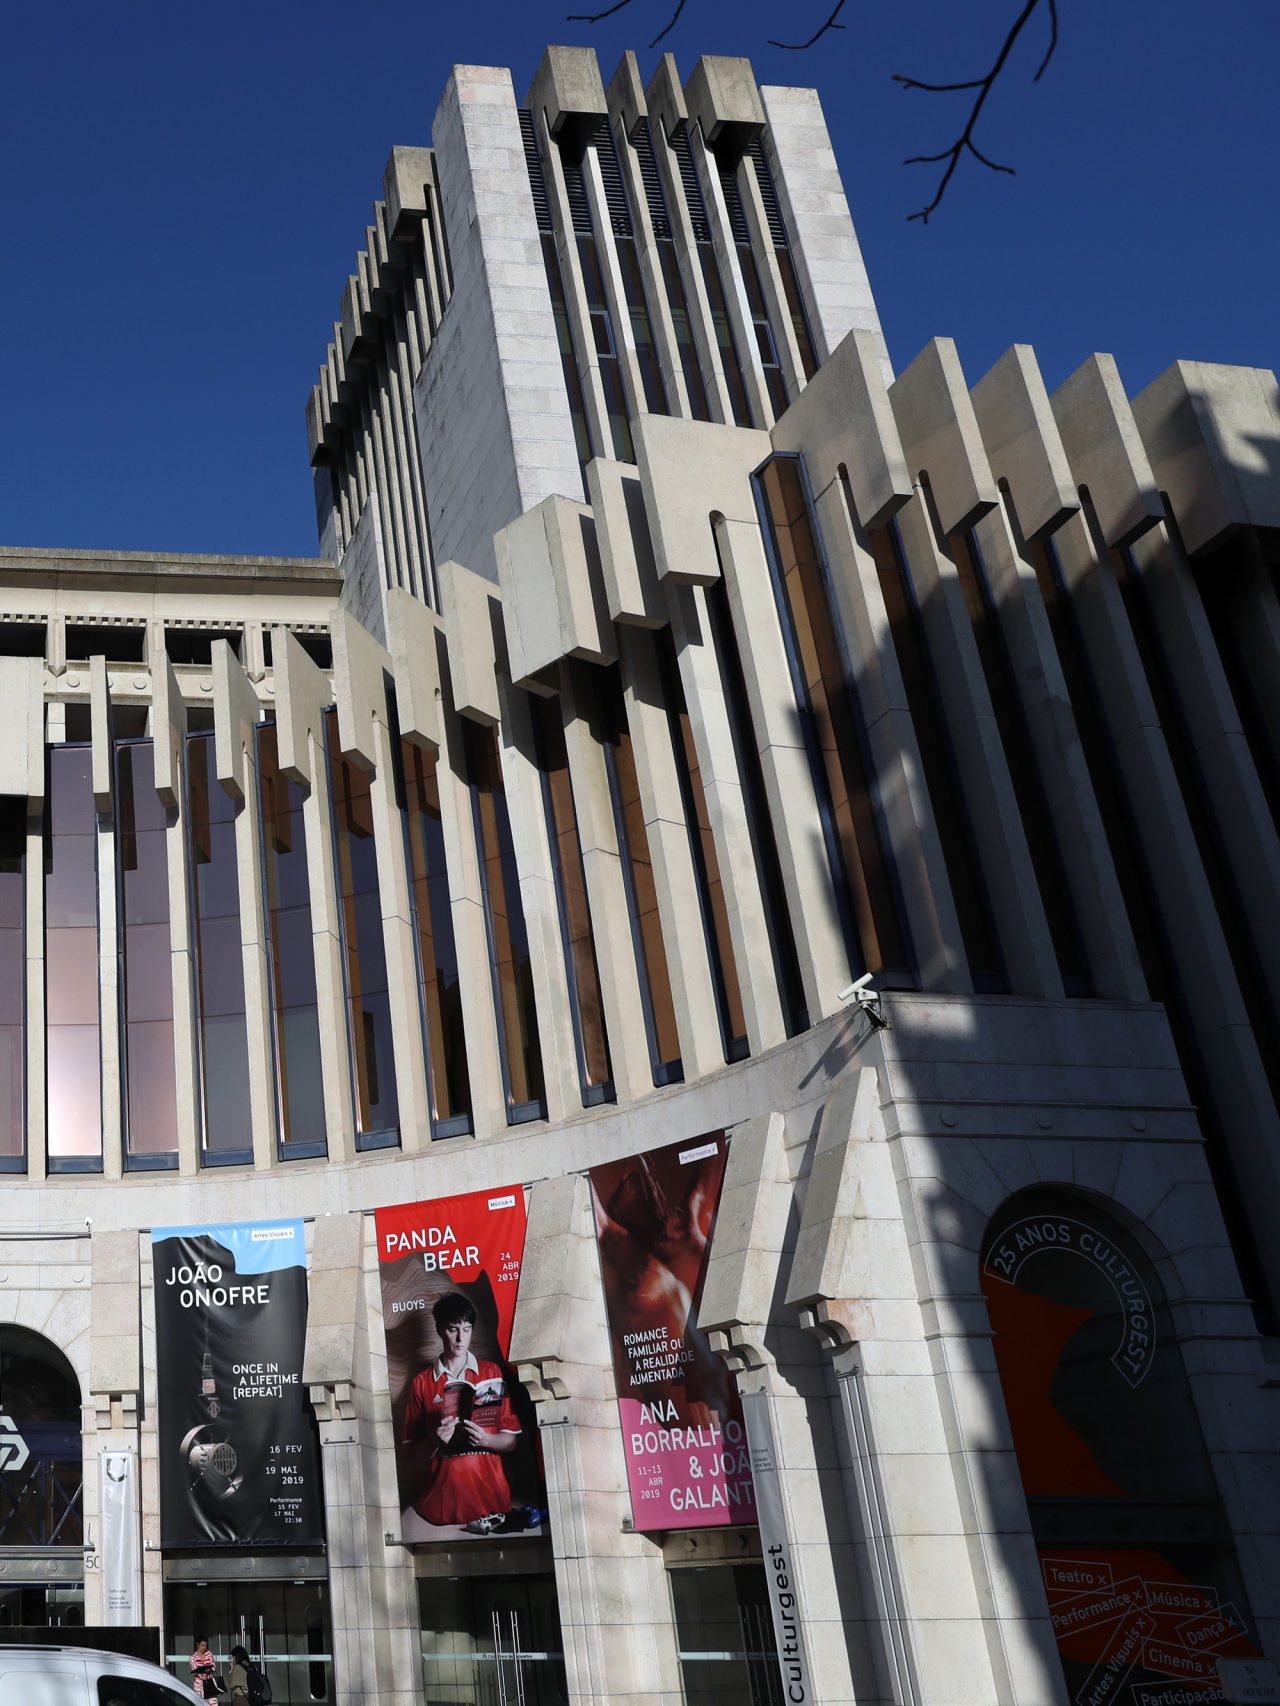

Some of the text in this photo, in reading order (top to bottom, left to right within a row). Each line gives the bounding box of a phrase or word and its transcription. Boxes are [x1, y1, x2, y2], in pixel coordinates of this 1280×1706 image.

[385, 1225, 457, 1253] PANDA
[423, 1246, 480, 1272] BEAR
[500, 1252, 511, 1261] 24
[502, 1261, 519, 1271] ABR
[165, 1261, 223, 1286] JOÃO
[497, 1271, 519, 1282] 2019
[392, 1299, 425, 1313] BUOYS
[993, 1223, 1148, 1374] 25 ANOS CULTURGEST
[624, 1327, 668, 1346] ROMANCE
[628, 1338, 684, 1359] FAMILIAR OU
[232, 1362, 278, 1374] ONCE IN
[635, 1351, 694, 1371] A REALIDADE
[240, 1373, 299, 1386] A LIFETIME
[630, 1367, 685, 1386] AUMENTADA
[233, 1385, 283, 1400] [REPEAT]
[640, 1399, 679, 1425] ANA
[631, 1420, 741, 1456] BORRALHO
[269, 1445, 302, 1454] 16 FEV
[265, 1466, 298, 1475] 19 MAI
[689, 1456, 703, 1479] &
[282, 1476, 304, 1485] 2019
[648, 1477, 663, 1486] ABR
[640, 1490, 660, 1499] 2019
[1050, 1568, 1094, 1585] Teatro
[1152, 1590, 1202, 1608] Música
[1052, 1593, 1131, 1628] Performance
[768, 1544, 805, 1704] Culturgest
[1186, 1621, 1225, 1646] Dança
[1088, 1674, 1113, 1706] Artes
[1106, 1627, 1140, 1674] Visuais
[1149, 1648, 1203, 1673] Cinema
[1140, 1687, 1224, 1706] Participação
